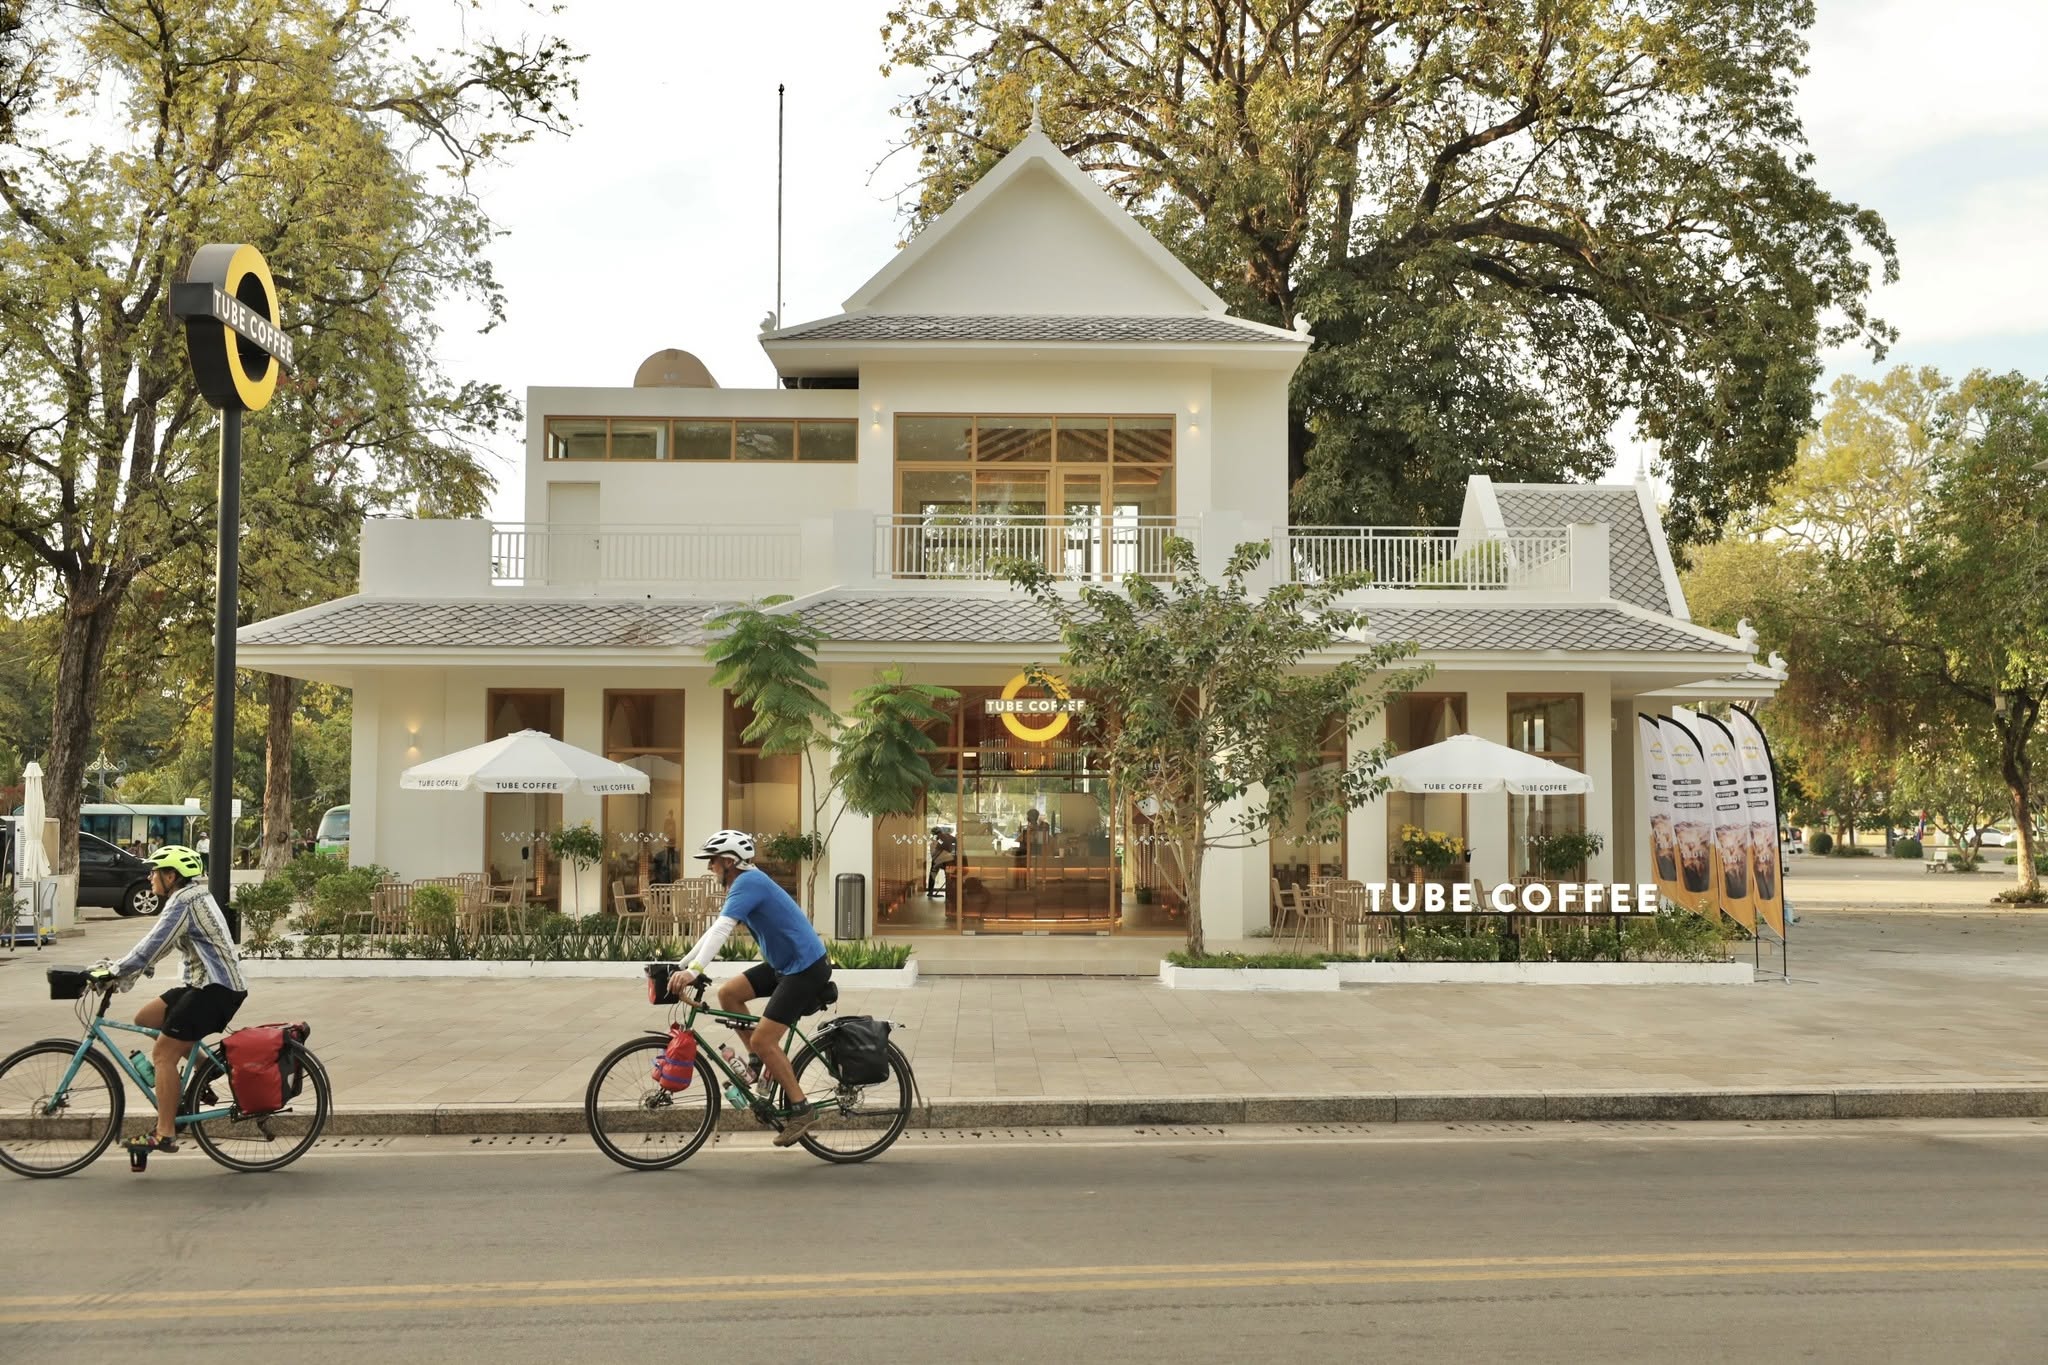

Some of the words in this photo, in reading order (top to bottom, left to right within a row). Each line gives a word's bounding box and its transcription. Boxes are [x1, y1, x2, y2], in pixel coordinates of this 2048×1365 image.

[215, 289, 246, 332] TUBE
[250, 315, 292, 363] COFFEE
[987, 701, 1023, 711] TUBE
[522, 782, 557, 790] COFFEE
[593, 784, 608, 792] TUBE
[1521, 784, 1537, 792] TUBE
[1540, 784, 1567, 792] COFFEE
[1366, 883, 1472, 912] TUBE
[1492, 883, 1658, 912] COFFEE
